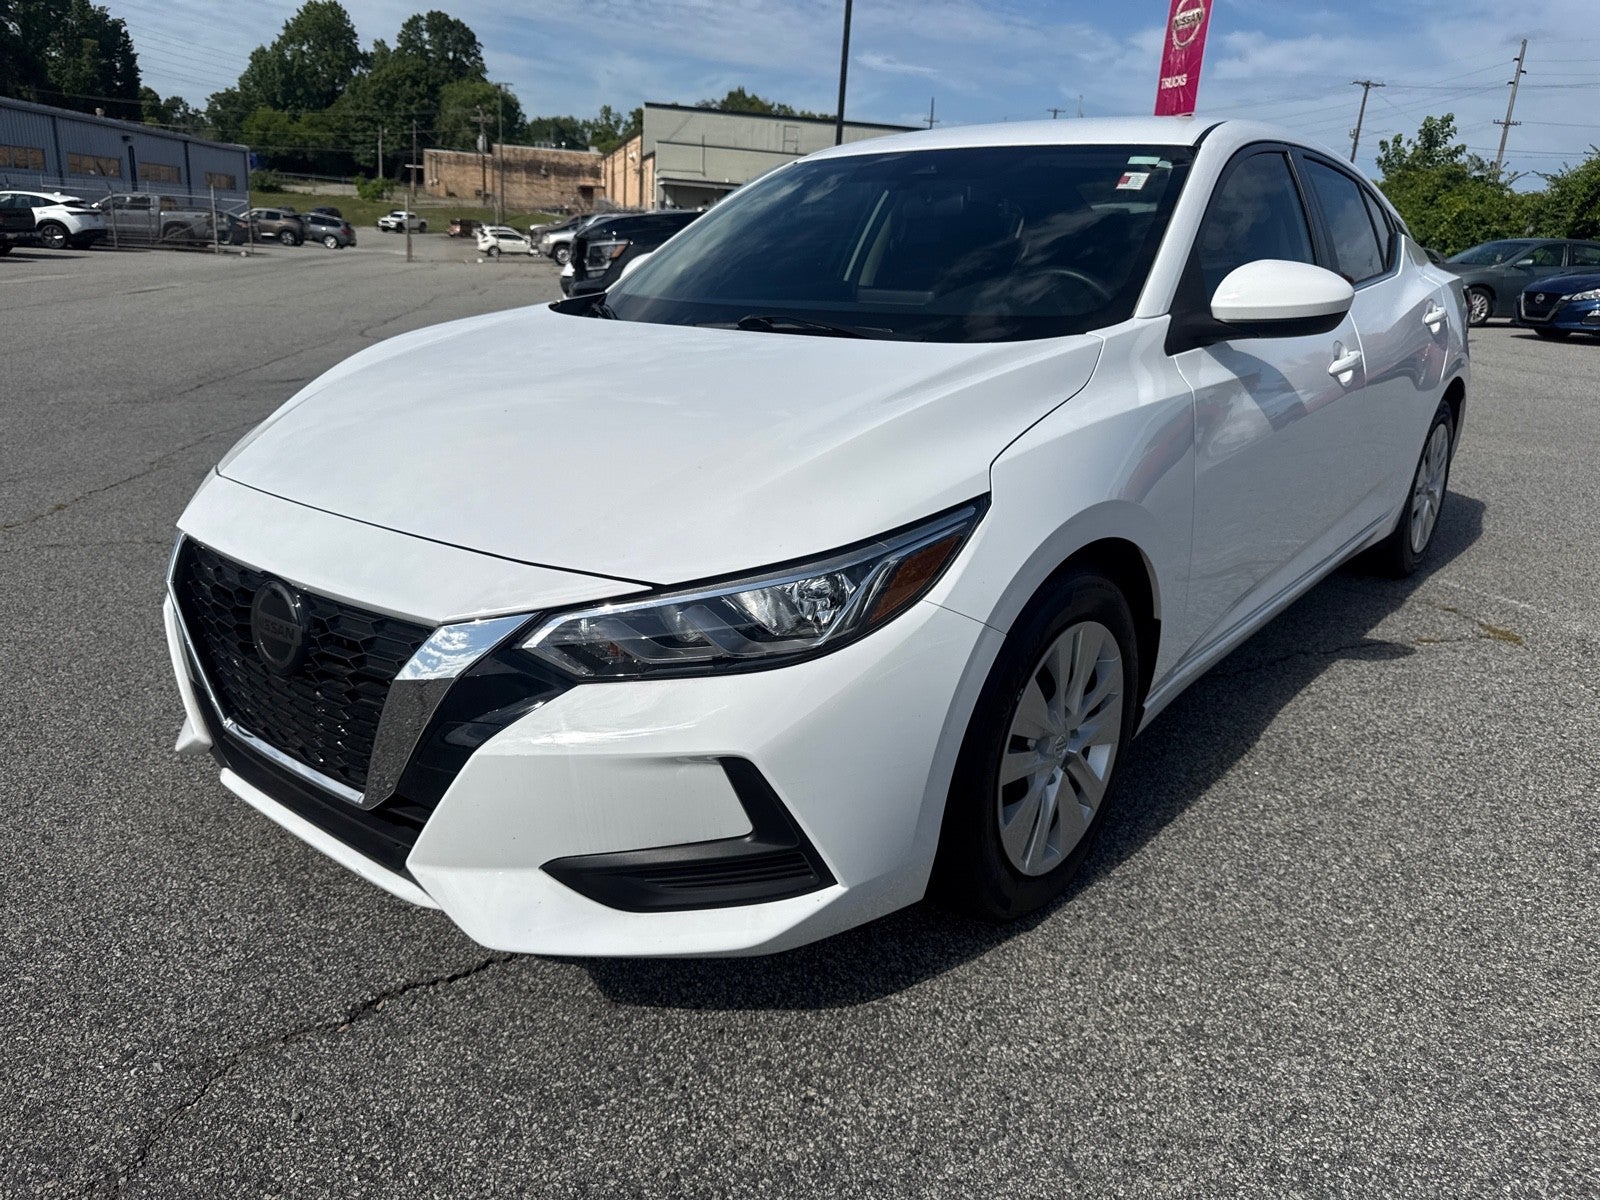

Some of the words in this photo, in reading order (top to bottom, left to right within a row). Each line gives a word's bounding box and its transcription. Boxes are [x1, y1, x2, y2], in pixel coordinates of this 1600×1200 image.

[1173, 11, 1202, 30] NISSAN
[1161, 74, 1187, 90] TRUCKS
[257, 614, 295, 640] NISSAN
